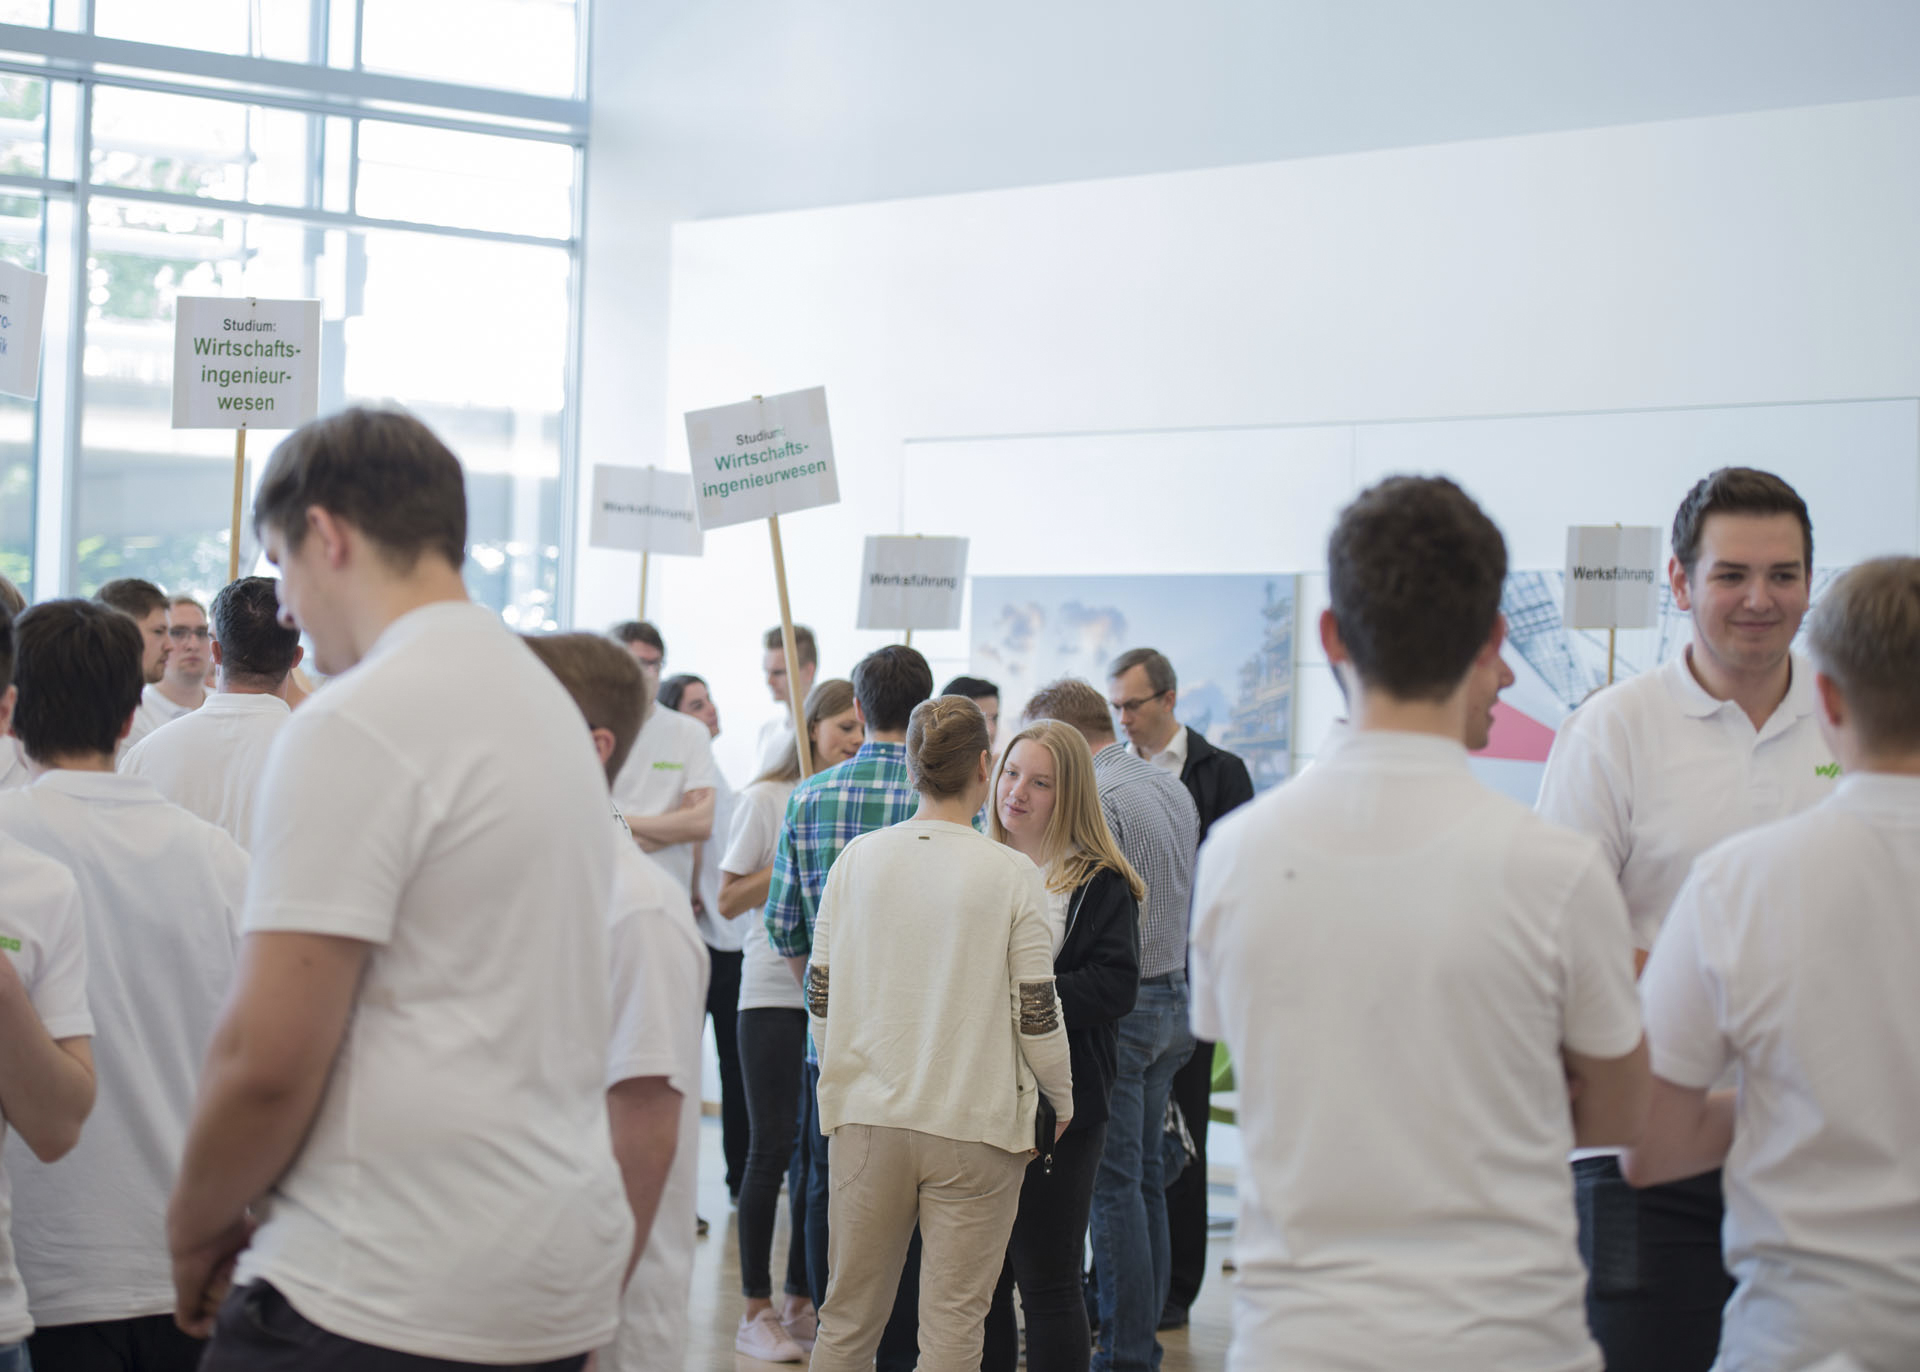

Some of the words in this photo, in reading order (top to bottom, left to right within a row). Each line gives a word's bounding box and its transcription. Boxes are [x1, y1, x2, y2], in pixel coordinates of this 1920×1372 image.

[223, 318, 277, 332] Studium:
[194, 337, 301, 358] Wirtschafts-
[201, 364, 292, 388] ingenieur-
[217, 396, 275, 411] wesen
[714, 441, 809, 471] Wirtschafts-
[702, 460, 827, 498] ingenieurwesen
[1573, 566, 1654, 584] Werksführung
